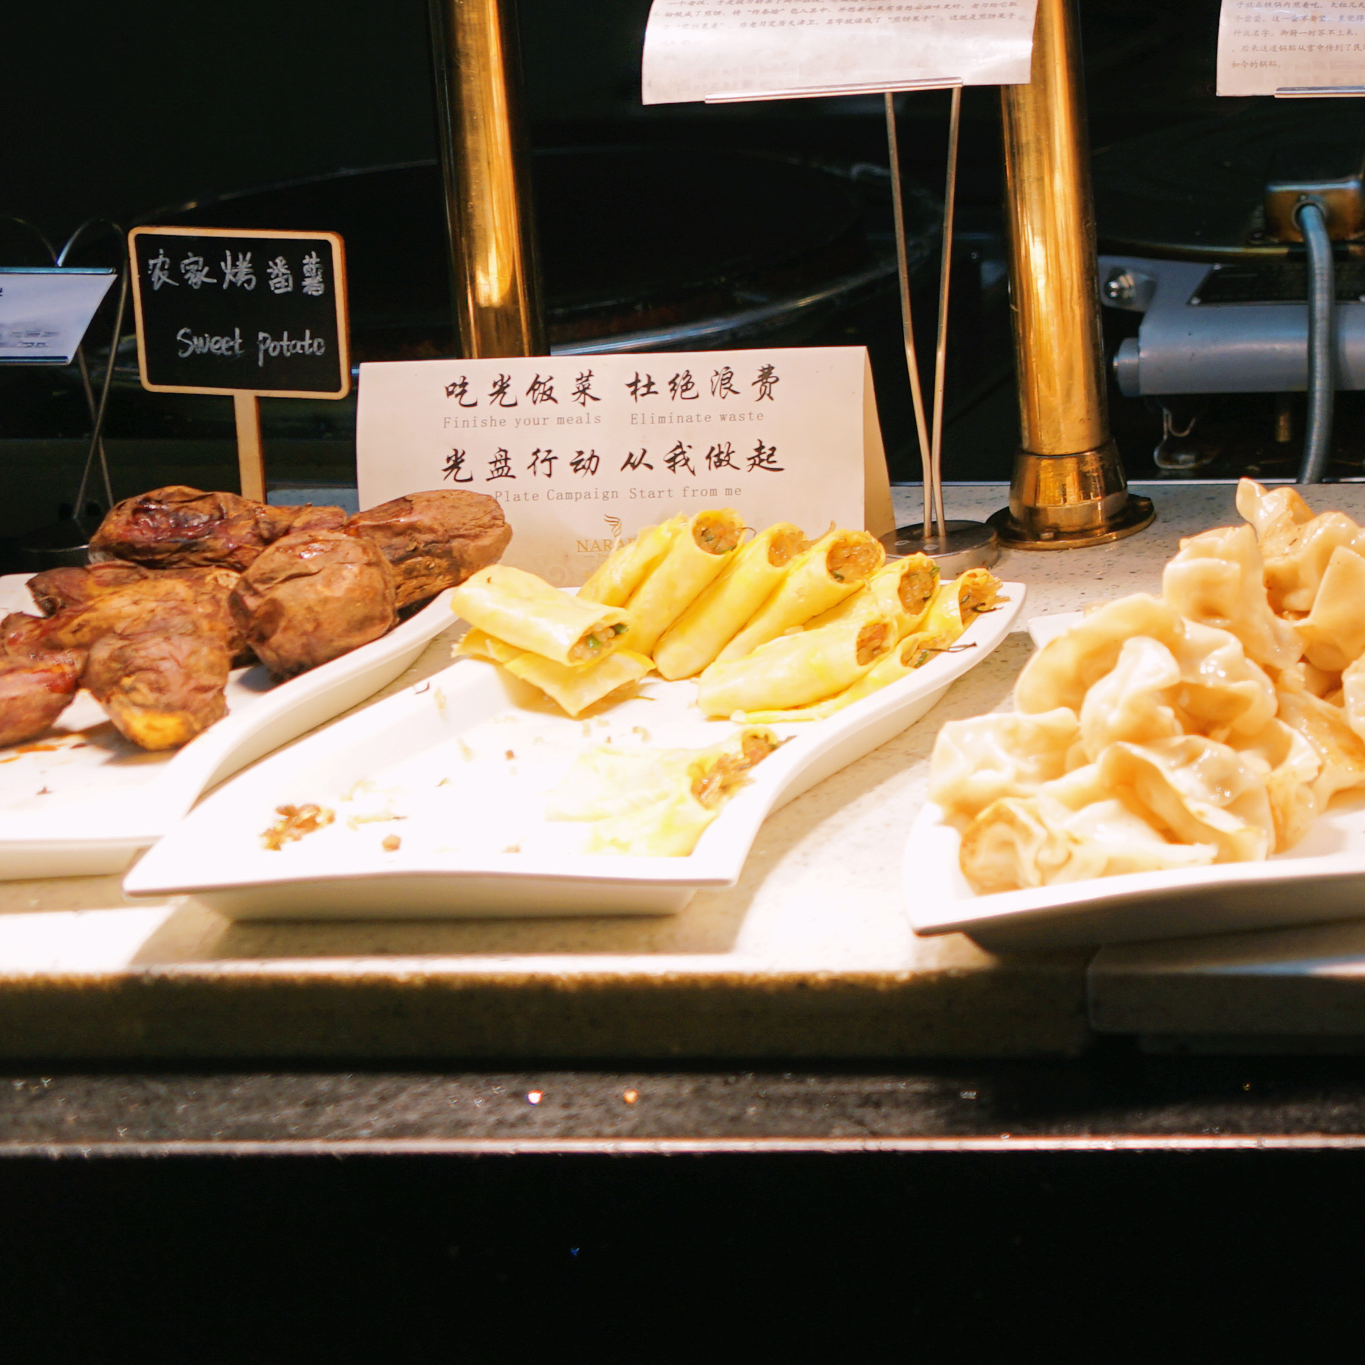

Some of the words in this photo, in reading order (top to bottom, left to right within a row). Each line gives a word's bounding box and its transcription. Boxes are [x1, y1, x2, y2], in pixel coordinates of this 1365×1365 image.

[148, 249, 325, 296] 农家烤番薯
[176, 327, 243, 358] Sweet
[444, 369, 602, 408] 吃光饭菜
[624, 363, 780, 403] 杜绝浪费
[443, 415, 507, 429] Finishe
[514, 414, 550, 429] your
[556, 412, 602, 426] meals
[630, 412, 712, 425] Eliminate
[719, 410, 764, 423] waste
[442, 447, 600, 483] 光盘行动
[620, 438, 785, 477] 从我做起
[495, 489, 539, 502] Plate
[546, 488, 619, 502] Campaign
[629, 487, 674, 499] Start
[682, 486, 718, 498] from
[725, 487, 742, 496] me
